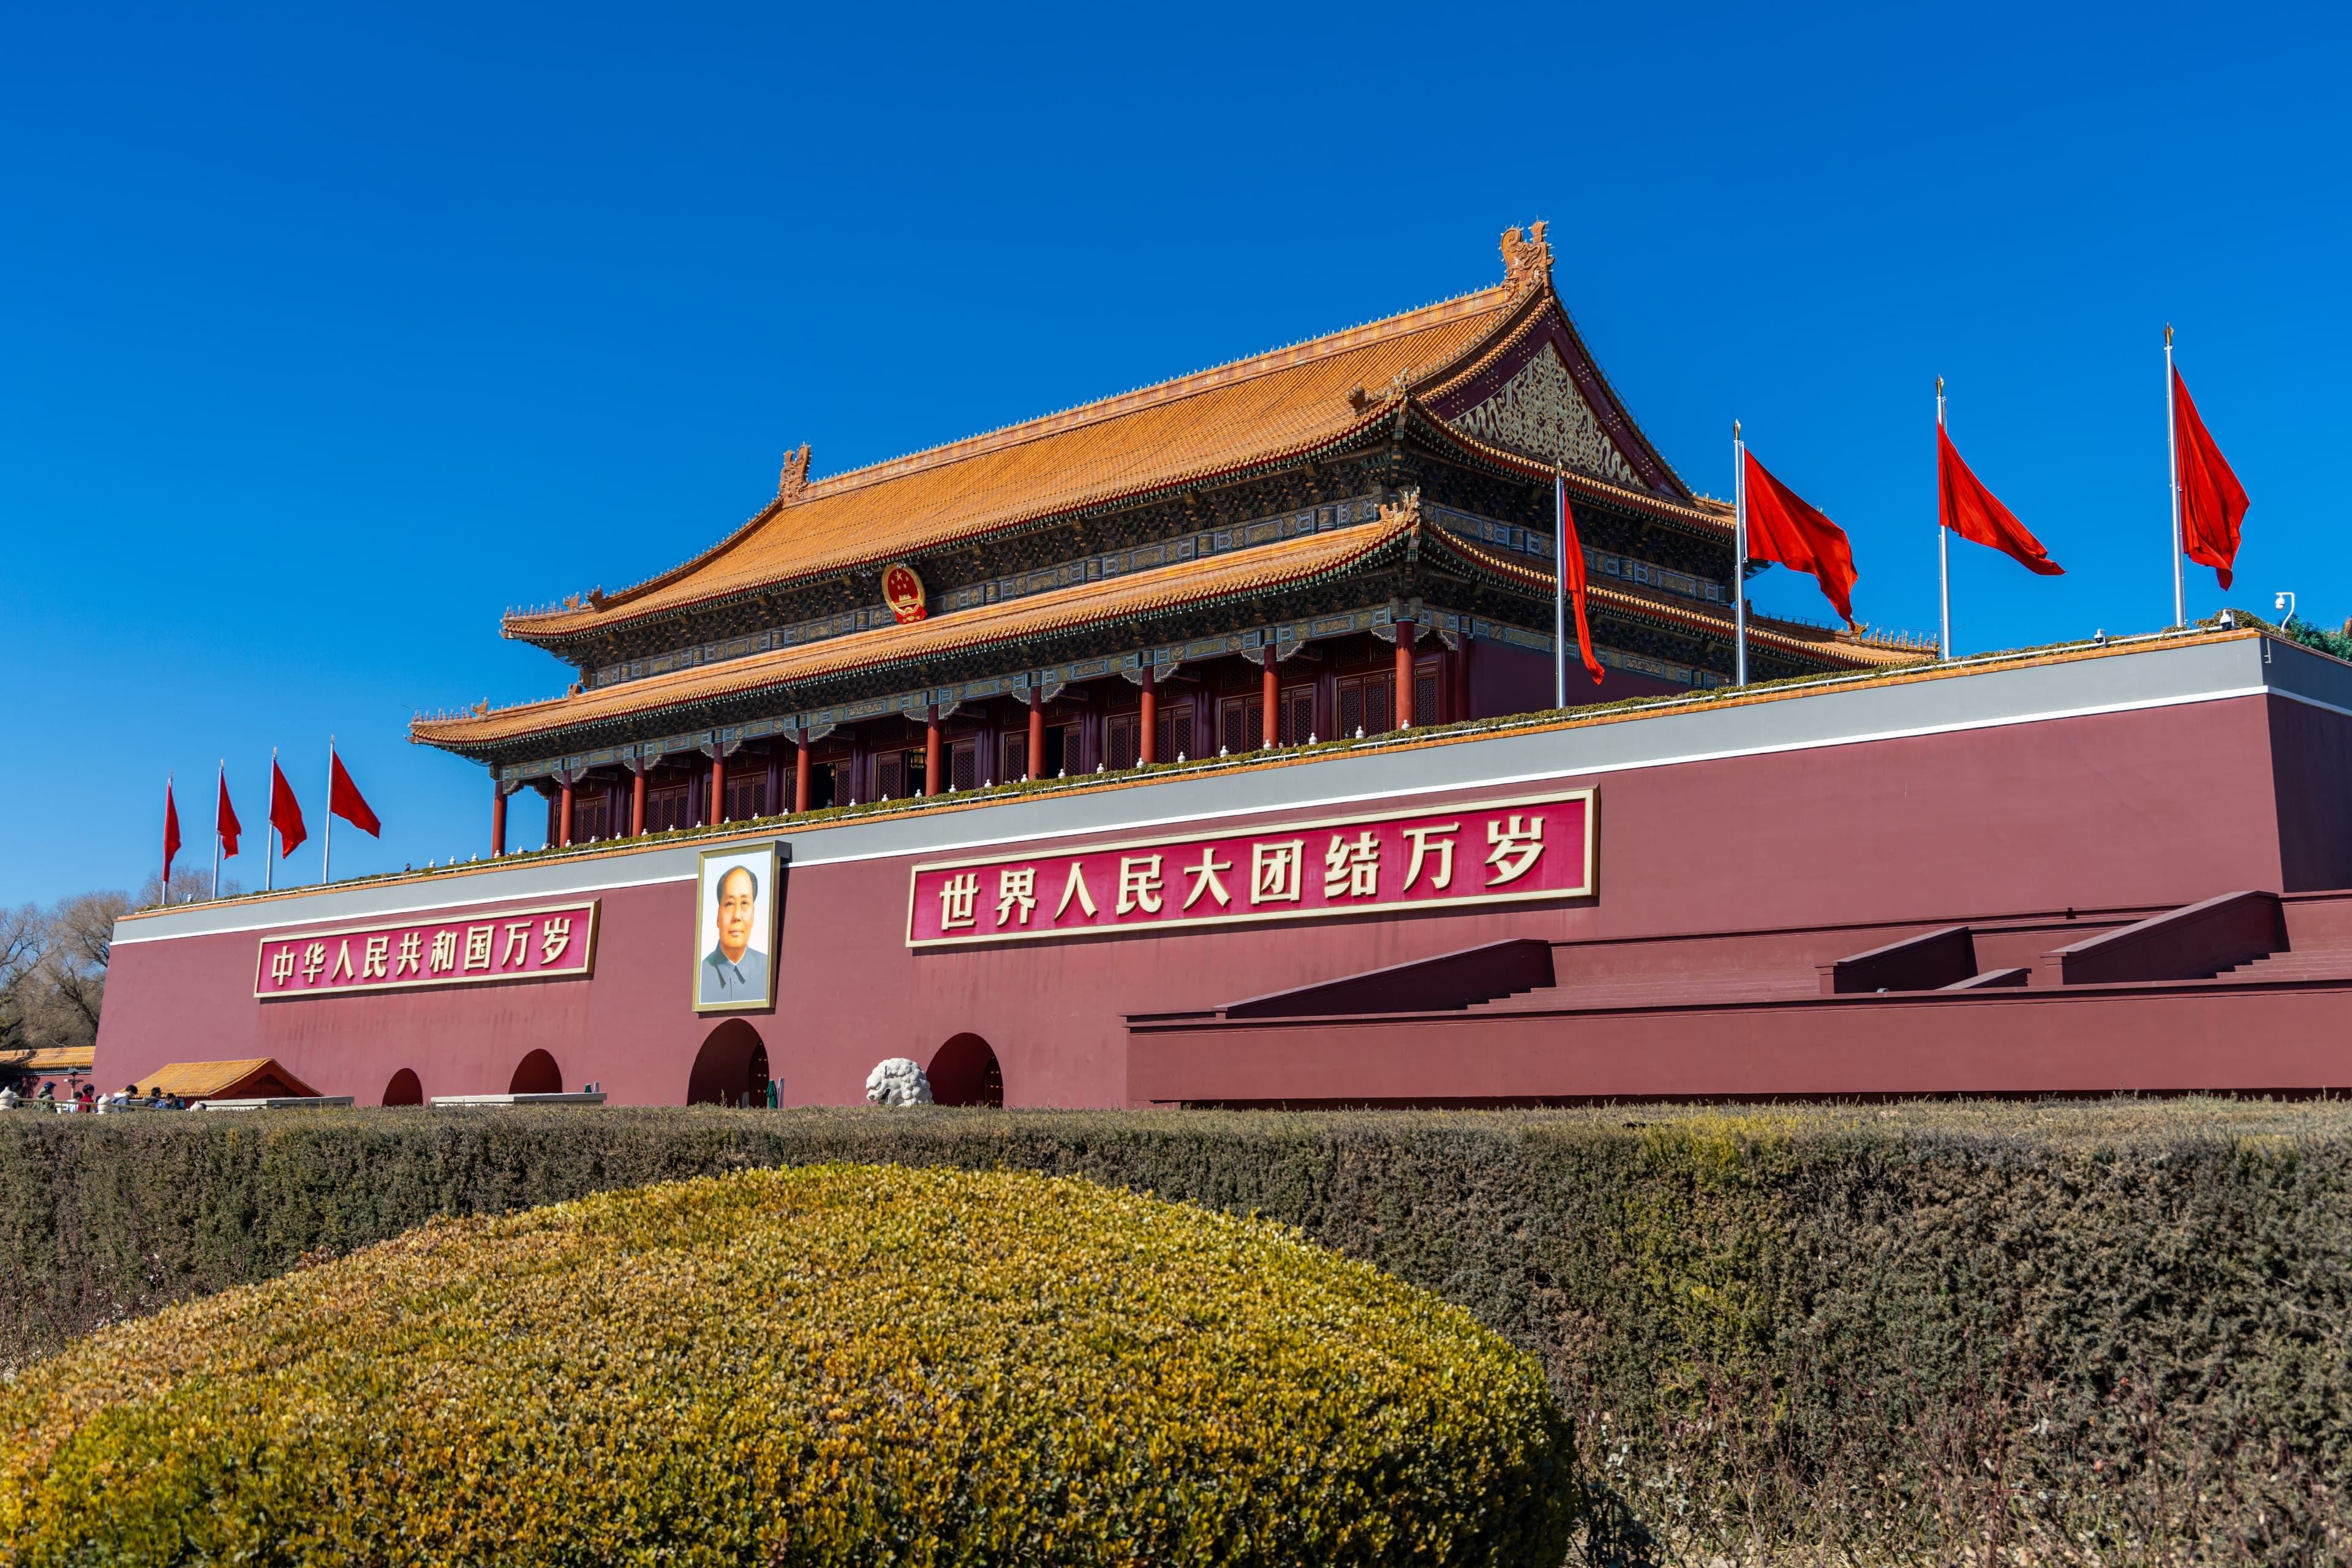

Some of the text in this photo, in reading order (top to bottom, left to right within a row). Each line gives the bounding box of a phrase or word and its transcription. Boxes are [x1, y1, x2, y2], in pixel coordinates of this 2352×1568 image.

[938, 815, 1545, 931] 世界人民大团结万岁
[270, 917, 571, 987] 中华人民共和国万岁
